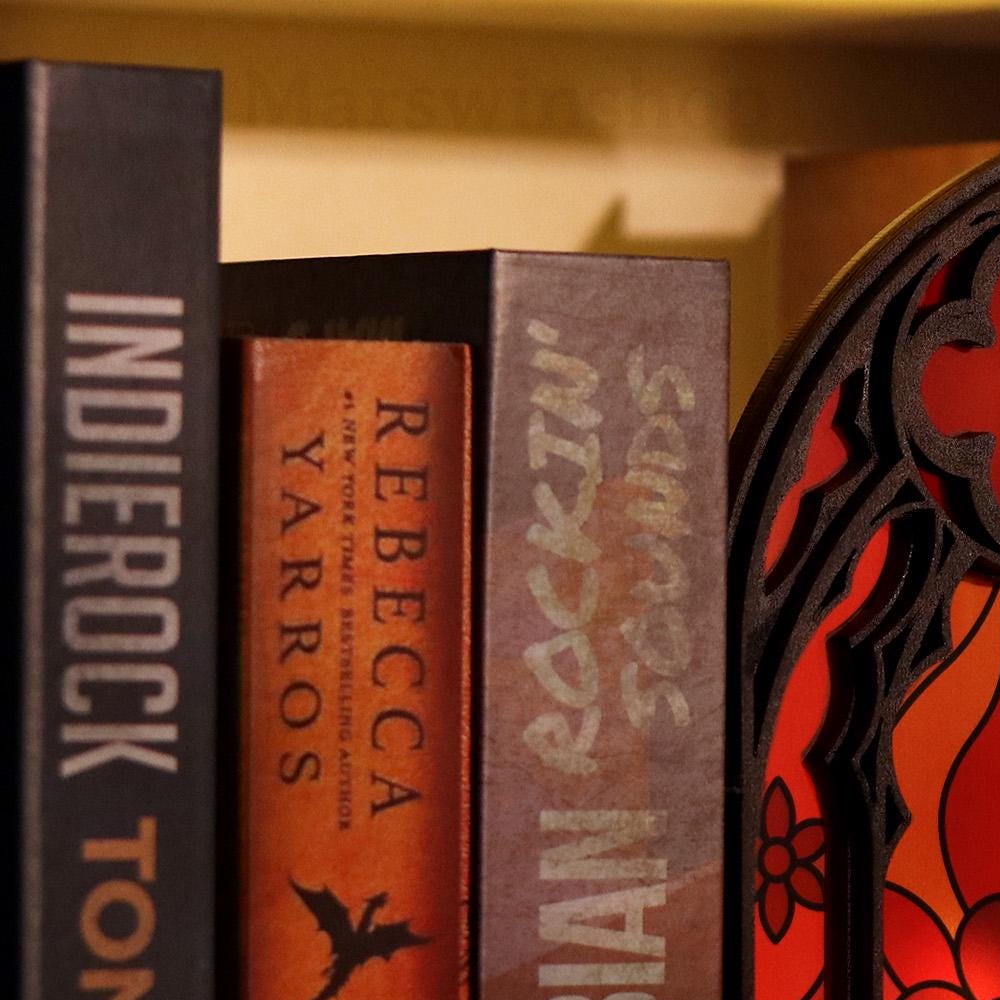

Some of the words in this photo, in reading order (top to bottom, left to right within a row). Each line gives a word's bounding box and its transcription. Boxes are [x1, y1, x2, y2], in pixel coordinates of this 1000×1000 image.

[342, 473, 355, 525] YORK
[343, 418, 355, 466] NEW
[59, 293, 184, 779] INDIEROCK
[340, 533, 354, 595] TIMES
[619, 343, 696, 730] SOUNDS
[278, 430, 325, 786] YARROS
[370, 398, 430, 818] REBECCA
[338, 609, 353, 741] BESTSELLING
[338, 749, 351, 831] AUTHOR
